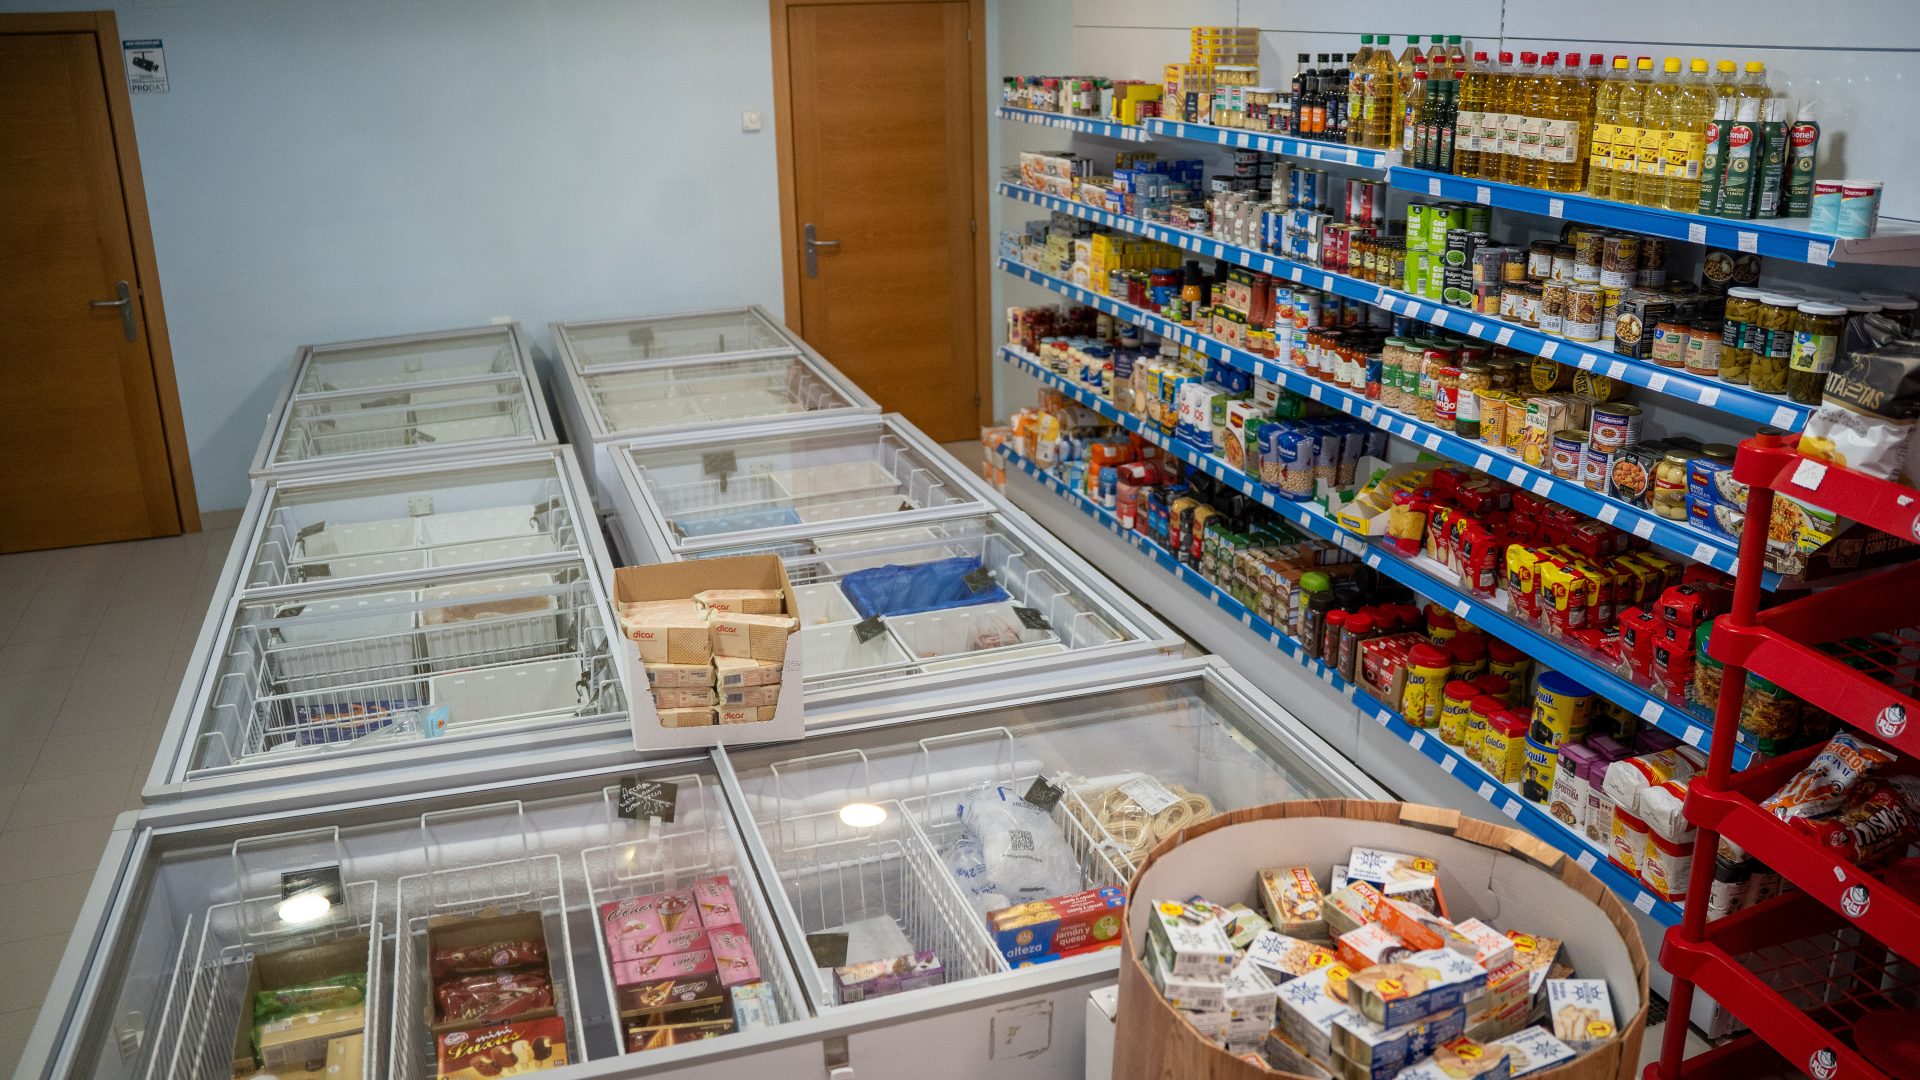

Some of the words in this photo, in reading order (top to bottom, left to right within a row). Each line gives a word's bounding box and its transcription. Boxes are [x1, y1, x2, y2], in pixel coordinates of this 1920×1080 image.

[132, 84, 165, 92] PRODAT
[1816, 185, 1836, 193] Gourmet
[1519, 568, 1529, 579] 1€
[1554, 584, 1564, 596] 1€
[716, 624, 737, 633] dicar
[632, 630, 654, 639] dicar
[724, 712, 744, 720] dicar
[1055, 926, 1083, 941] jamón
[1060, 934, 1087, 947] queso
[1007, 944, 1043, 958] alteza
[476, 1026, 512, 1043] mini
